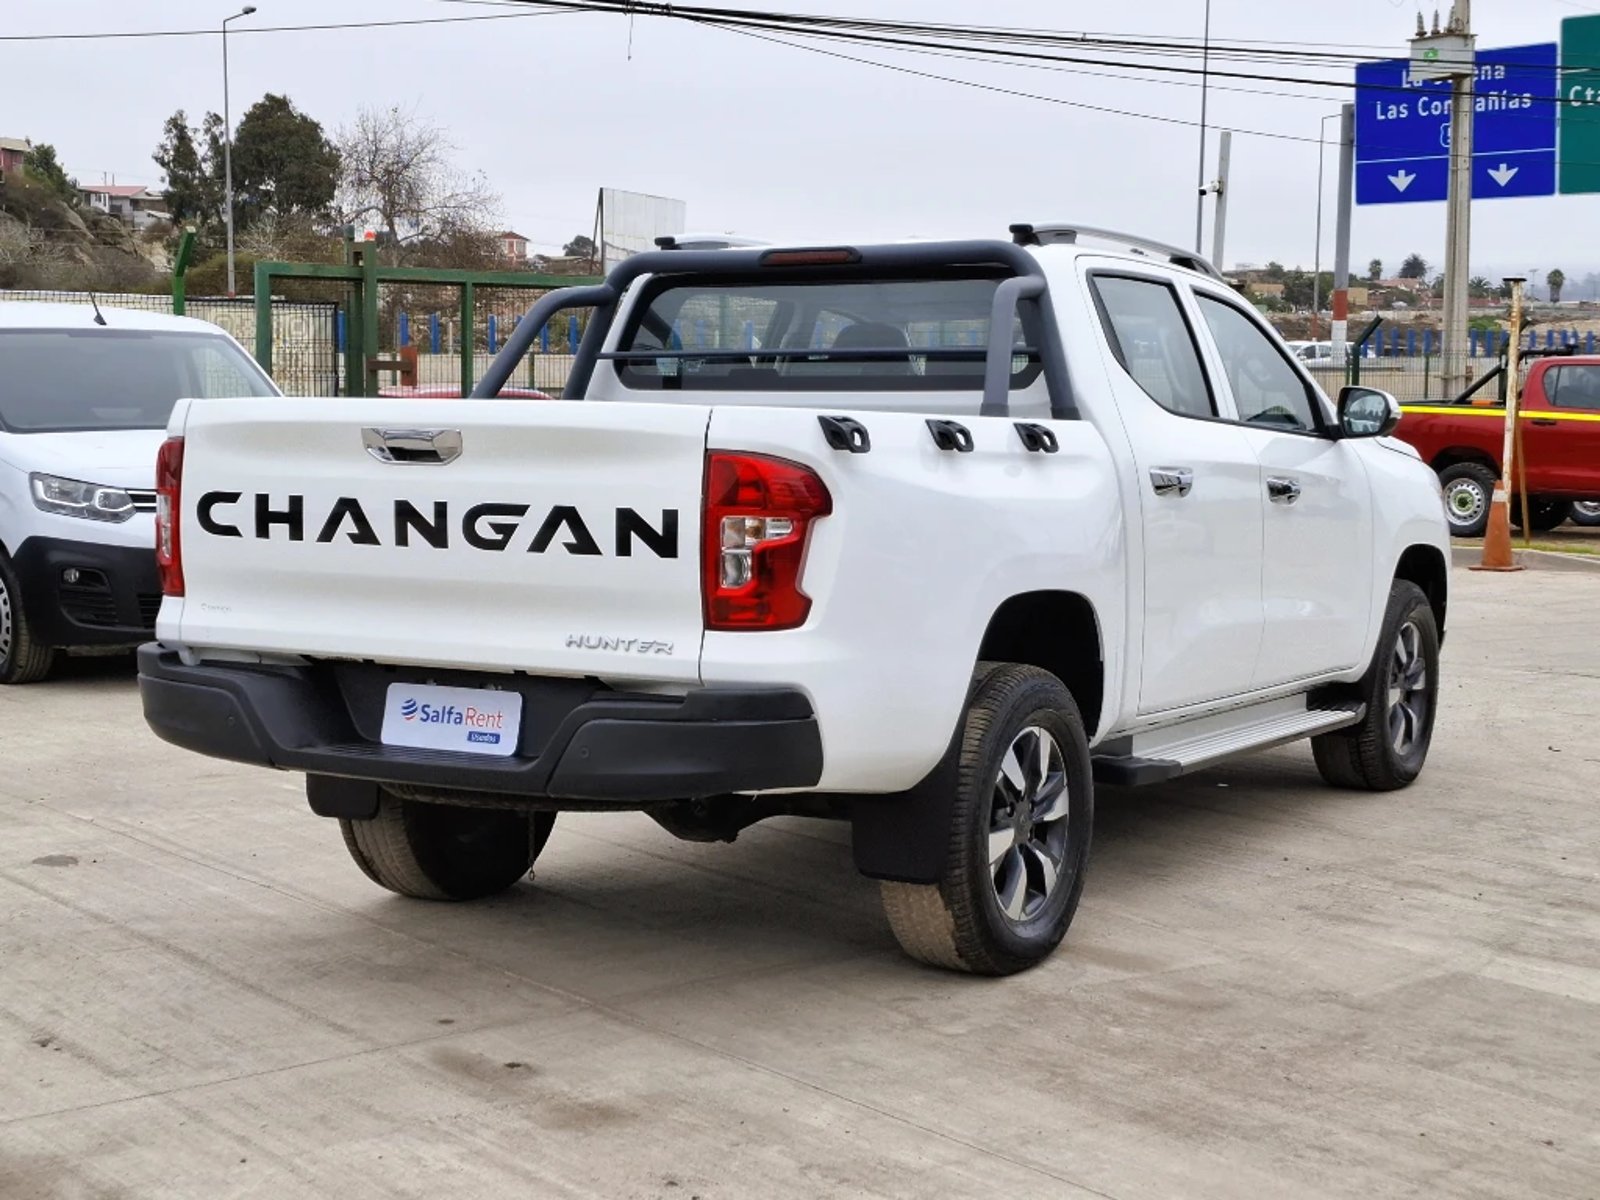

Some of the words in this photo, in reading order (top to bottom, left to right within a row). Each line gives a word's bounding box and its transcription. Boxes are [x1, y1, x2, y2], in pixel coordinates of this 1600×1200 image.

[1377, 101, 1408, 120] Las
[1418, 90, 1532, 117] Coañías
[1570, 86, 1600, 106] Ct
[196, 491, 679, 559] CHANGAN
[565, 634, 674, 655] HUNTER
[420, 704, 502, 728] SalfaRent
